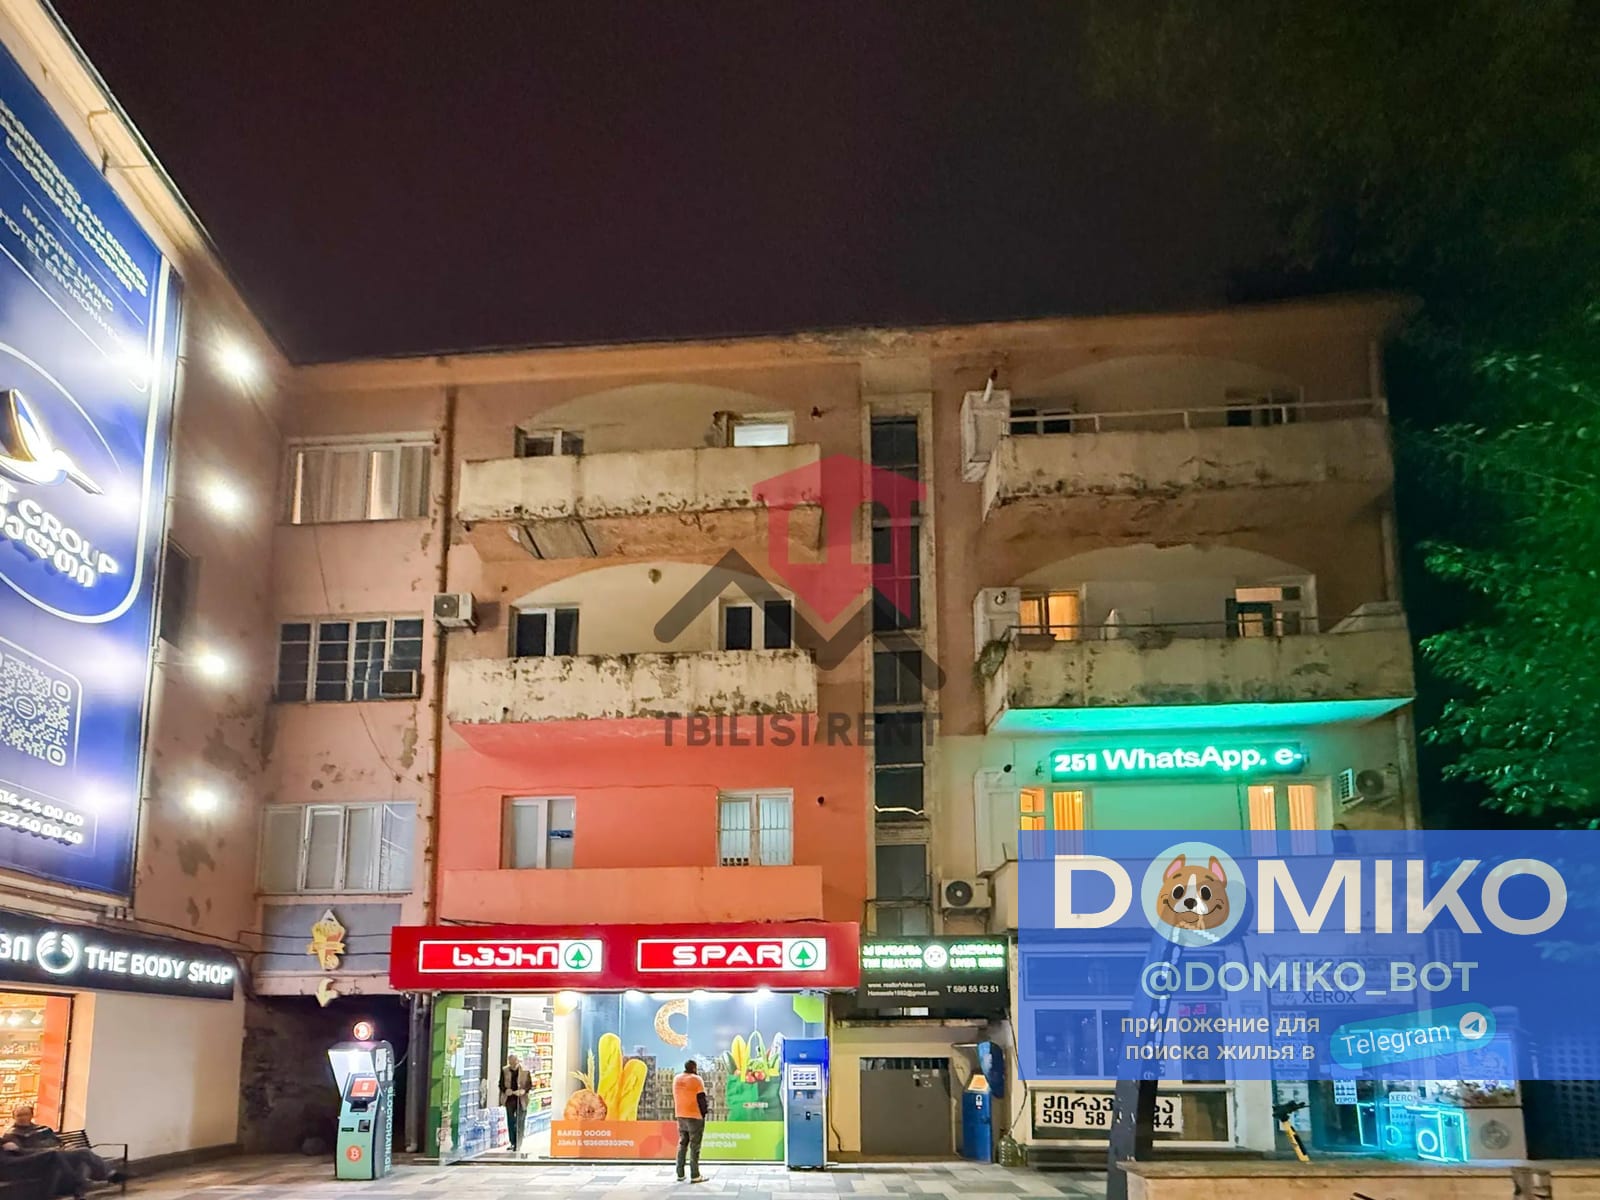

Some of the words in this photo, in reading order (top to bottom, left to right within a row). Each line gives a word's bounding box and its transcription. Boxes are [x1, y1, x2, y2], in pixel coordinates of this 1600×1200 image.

[22, 203, 76, 269] IMAGINE
[76, 262, 114, 312] LIVING
[35, 231, 50, 252] IN
[50, 249, 59, 268] A
[18, 499, 119, 574] GROUP
[1054, 754, 1097, 773] 251
[1102, 746, 1266, 771] WhatsApp.
[85, 947, 128, 973] THE
[130, 953, 185, 980] BODY
[187, 960, 233, 984] SHOP
[672, 945, 782, 966] SPAR
[990, 985, 999, 993] 51
[1302, 991, 1357, 1003] XEROX
[1043, 1110, 1074, 1125] 599
[1085, 1112, 1106, 1126] 58
